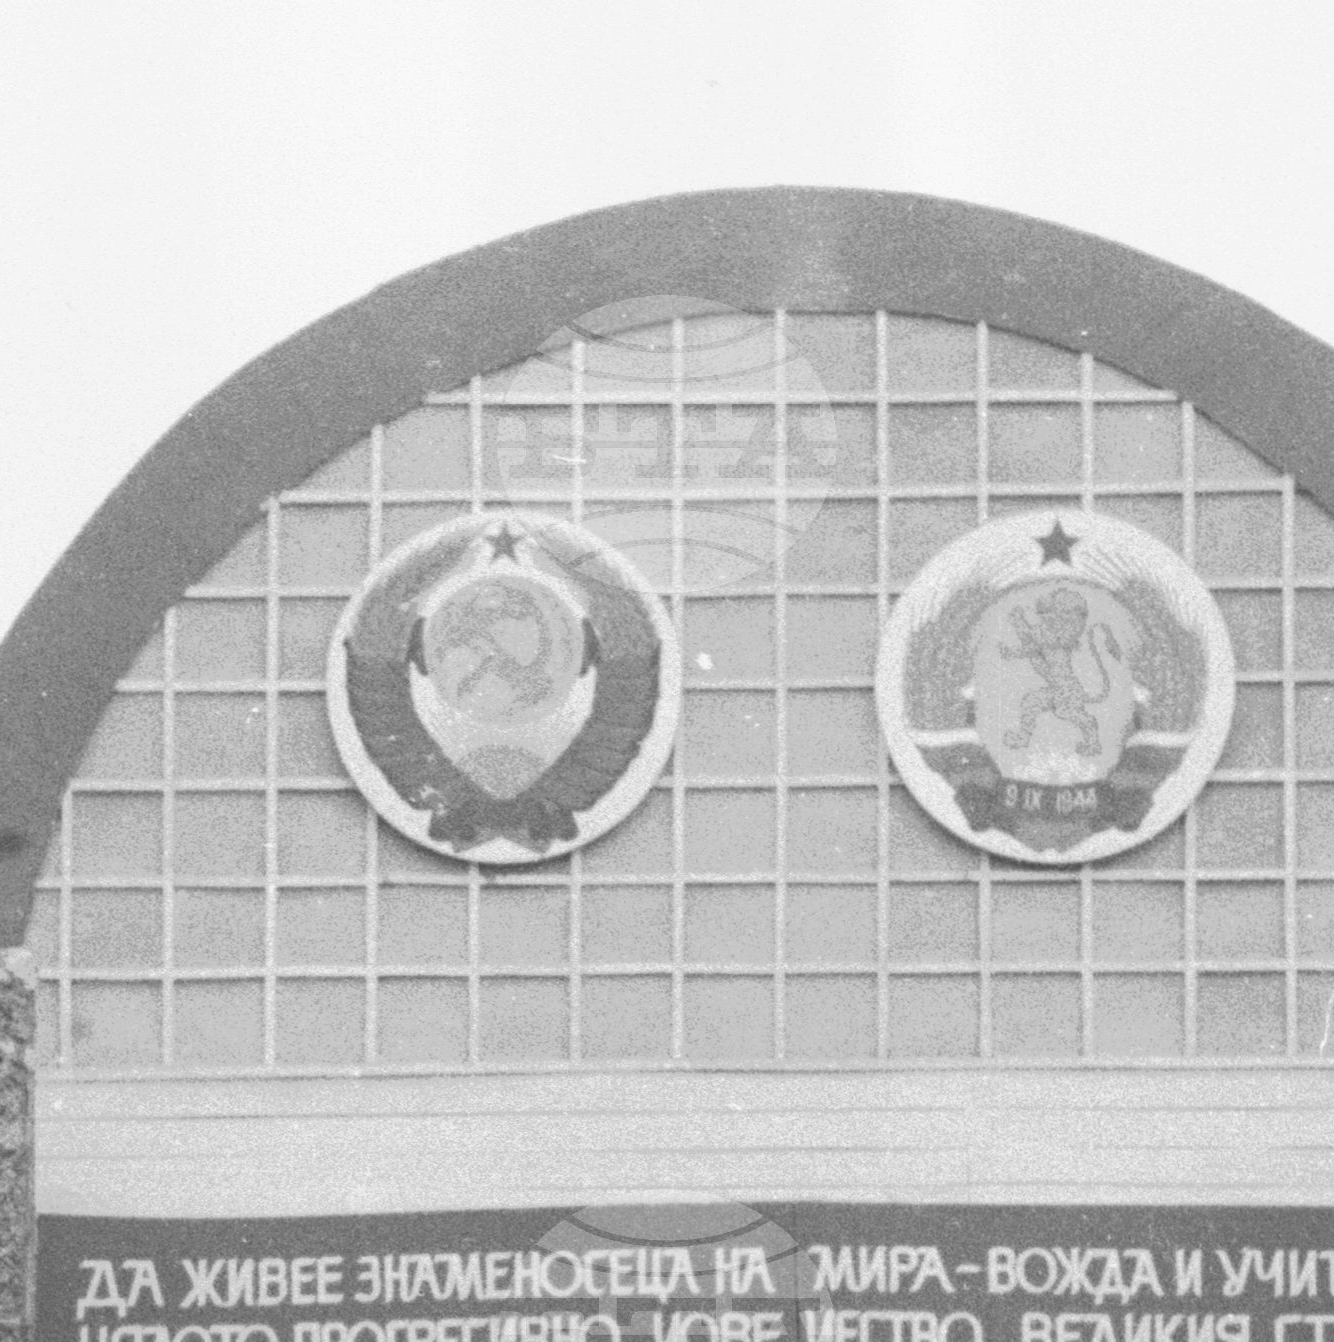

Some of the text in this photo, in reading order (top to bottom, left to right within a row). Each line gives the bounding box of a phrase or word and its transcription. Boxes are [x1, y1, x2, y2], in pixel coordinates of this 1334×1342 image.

[76, 1259, 163, 1318] ДА
[180, 1256, 344, 1309] ЖИВЕЕ
[356, 1247, 701, 1303] ЗНАМЕНОСЕЦА
[714, 1246, 775, 1293] НА
[1176, 1249, 1202, 1297] И
